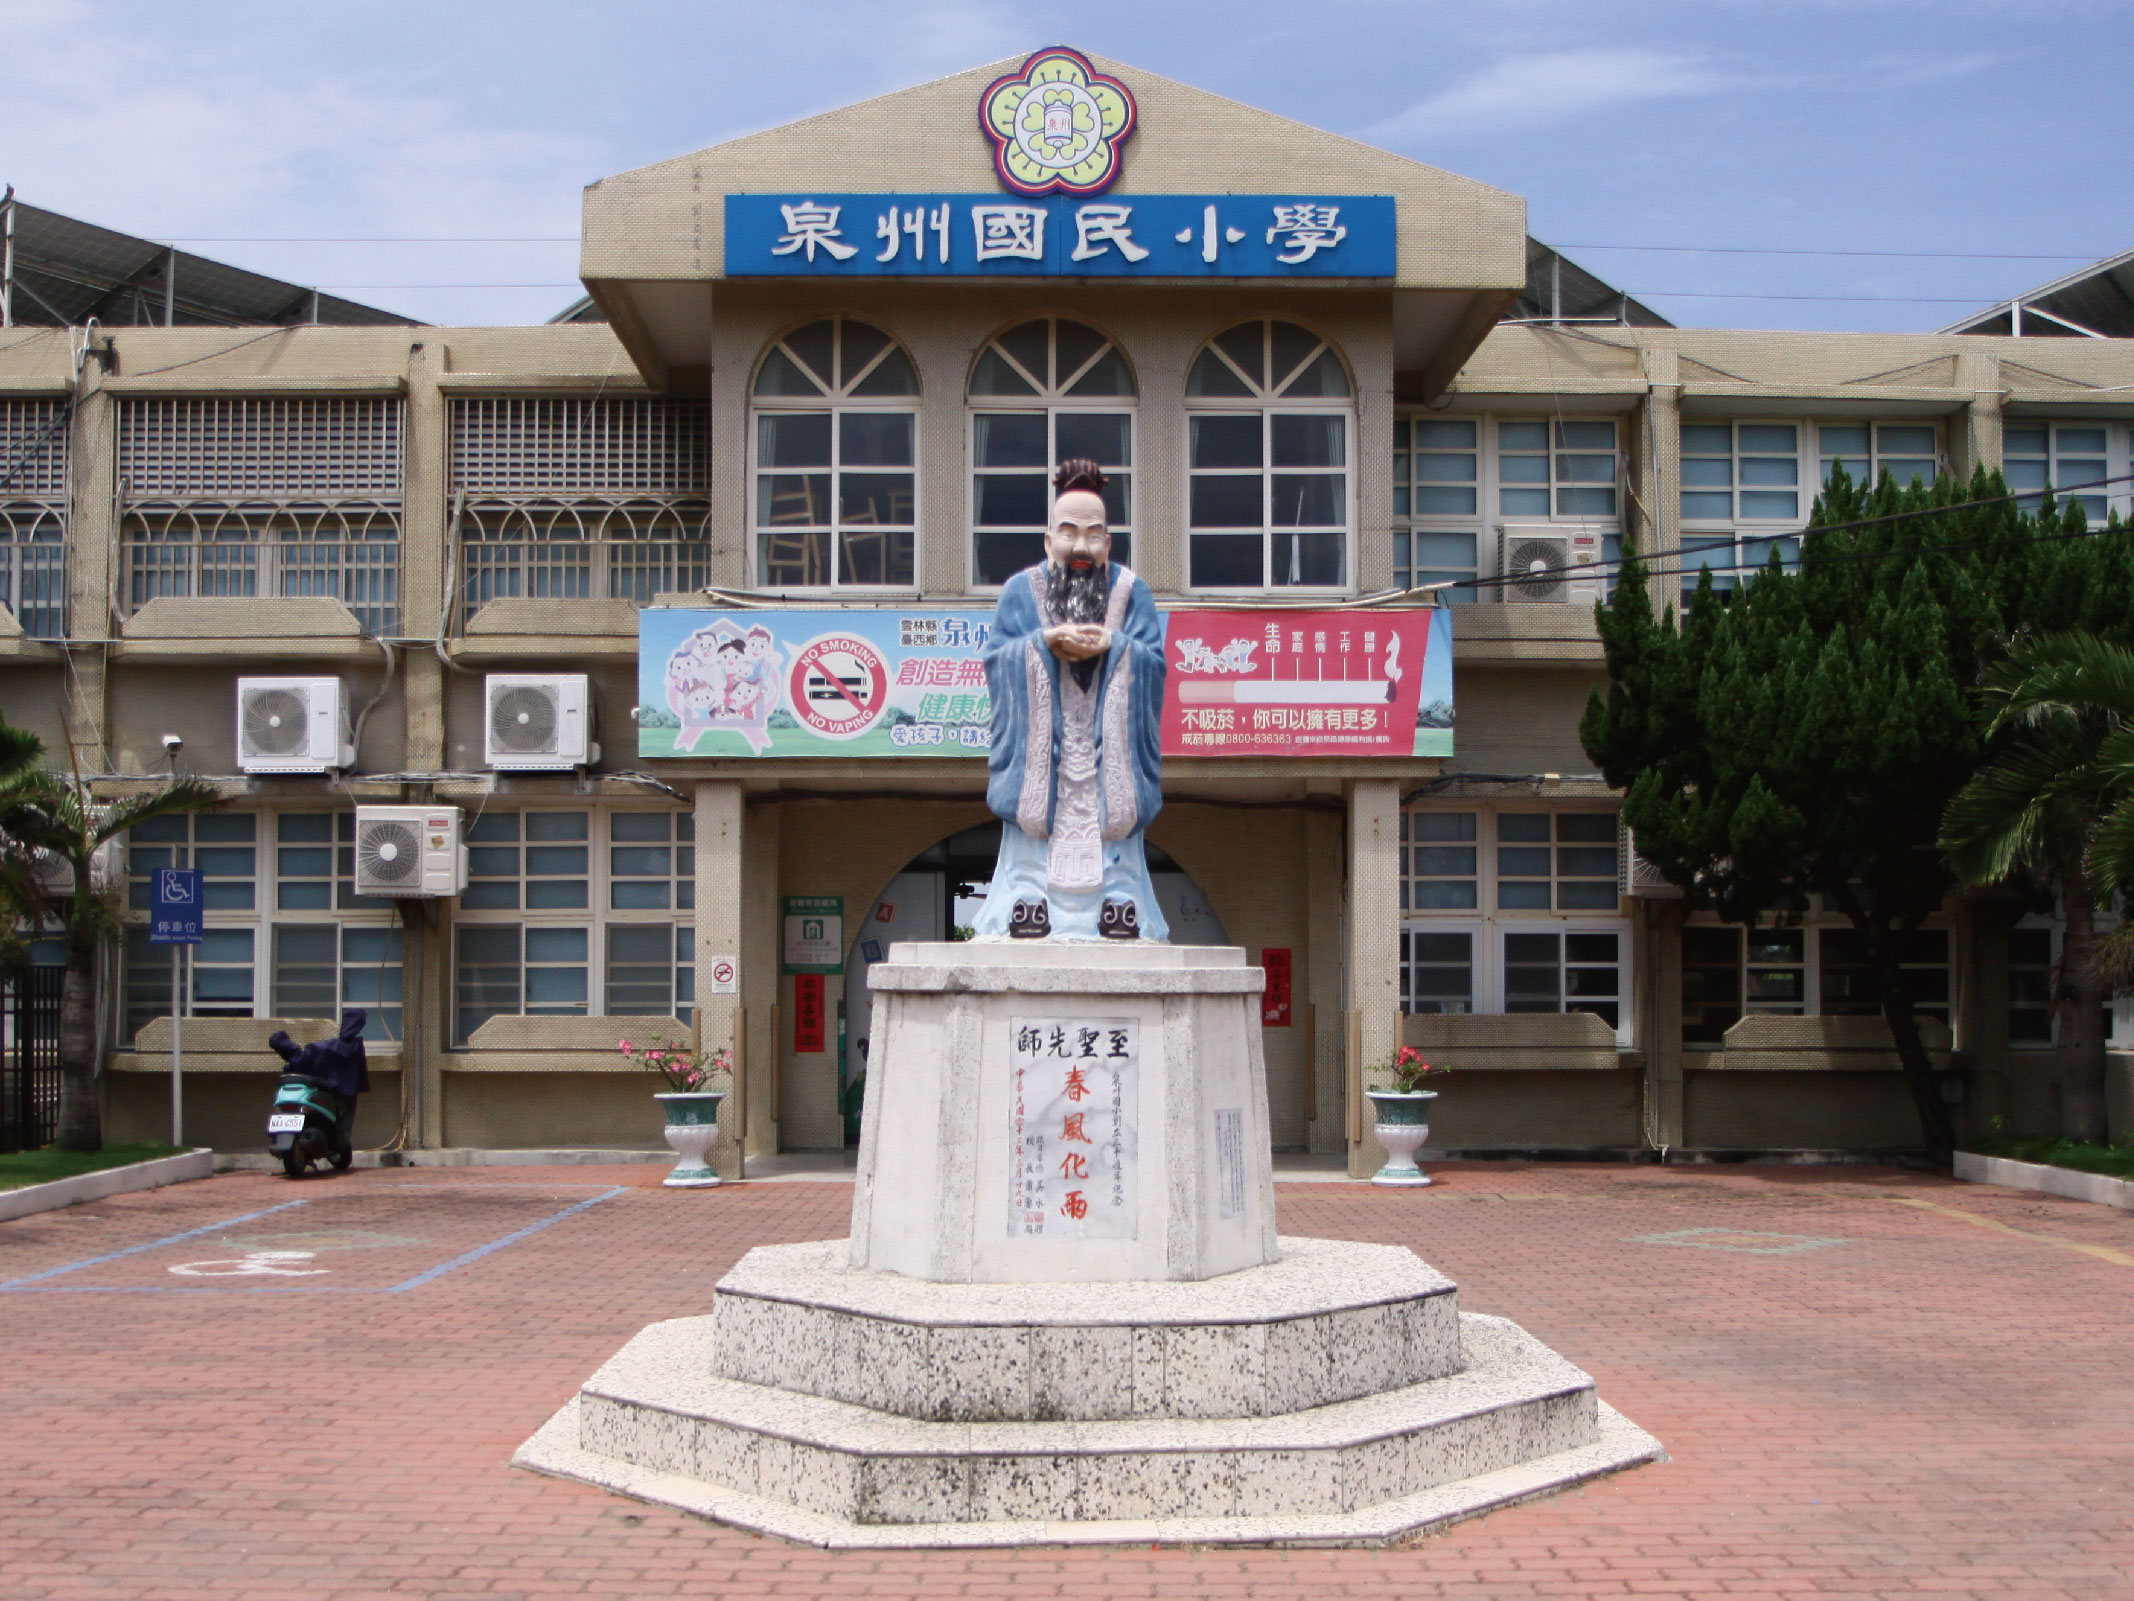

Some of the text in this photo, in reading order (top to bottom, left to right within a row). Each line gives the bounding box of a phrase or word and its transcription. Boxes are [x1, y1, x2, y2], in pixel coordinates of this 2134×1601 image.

[1047, 118, 1070, 131] 泉州
[771, 201, 1348, 263] 泉州國民小學
[901, 620, 938, 632] 雲林縣
[1264, 622, 1281, 654] 生命
[1291, 631, 1304, 653] 家庭
[1314, 631, 1326, 653] 感情
[1339, 631, 1351, 653] 工作
[1364, 631, 1375, 653] 健康
[801, 640, 878, 668] NO SMOKING
[896, 658, 989, 687] 創造無
[807, 709, 873, 733] NO VAPING
[158, 920, 197, 933] 停車位
[1017, 1026, 1130, 1059] 至聖先師
[1057, 1065, 1093, 1220] 春風化雨
